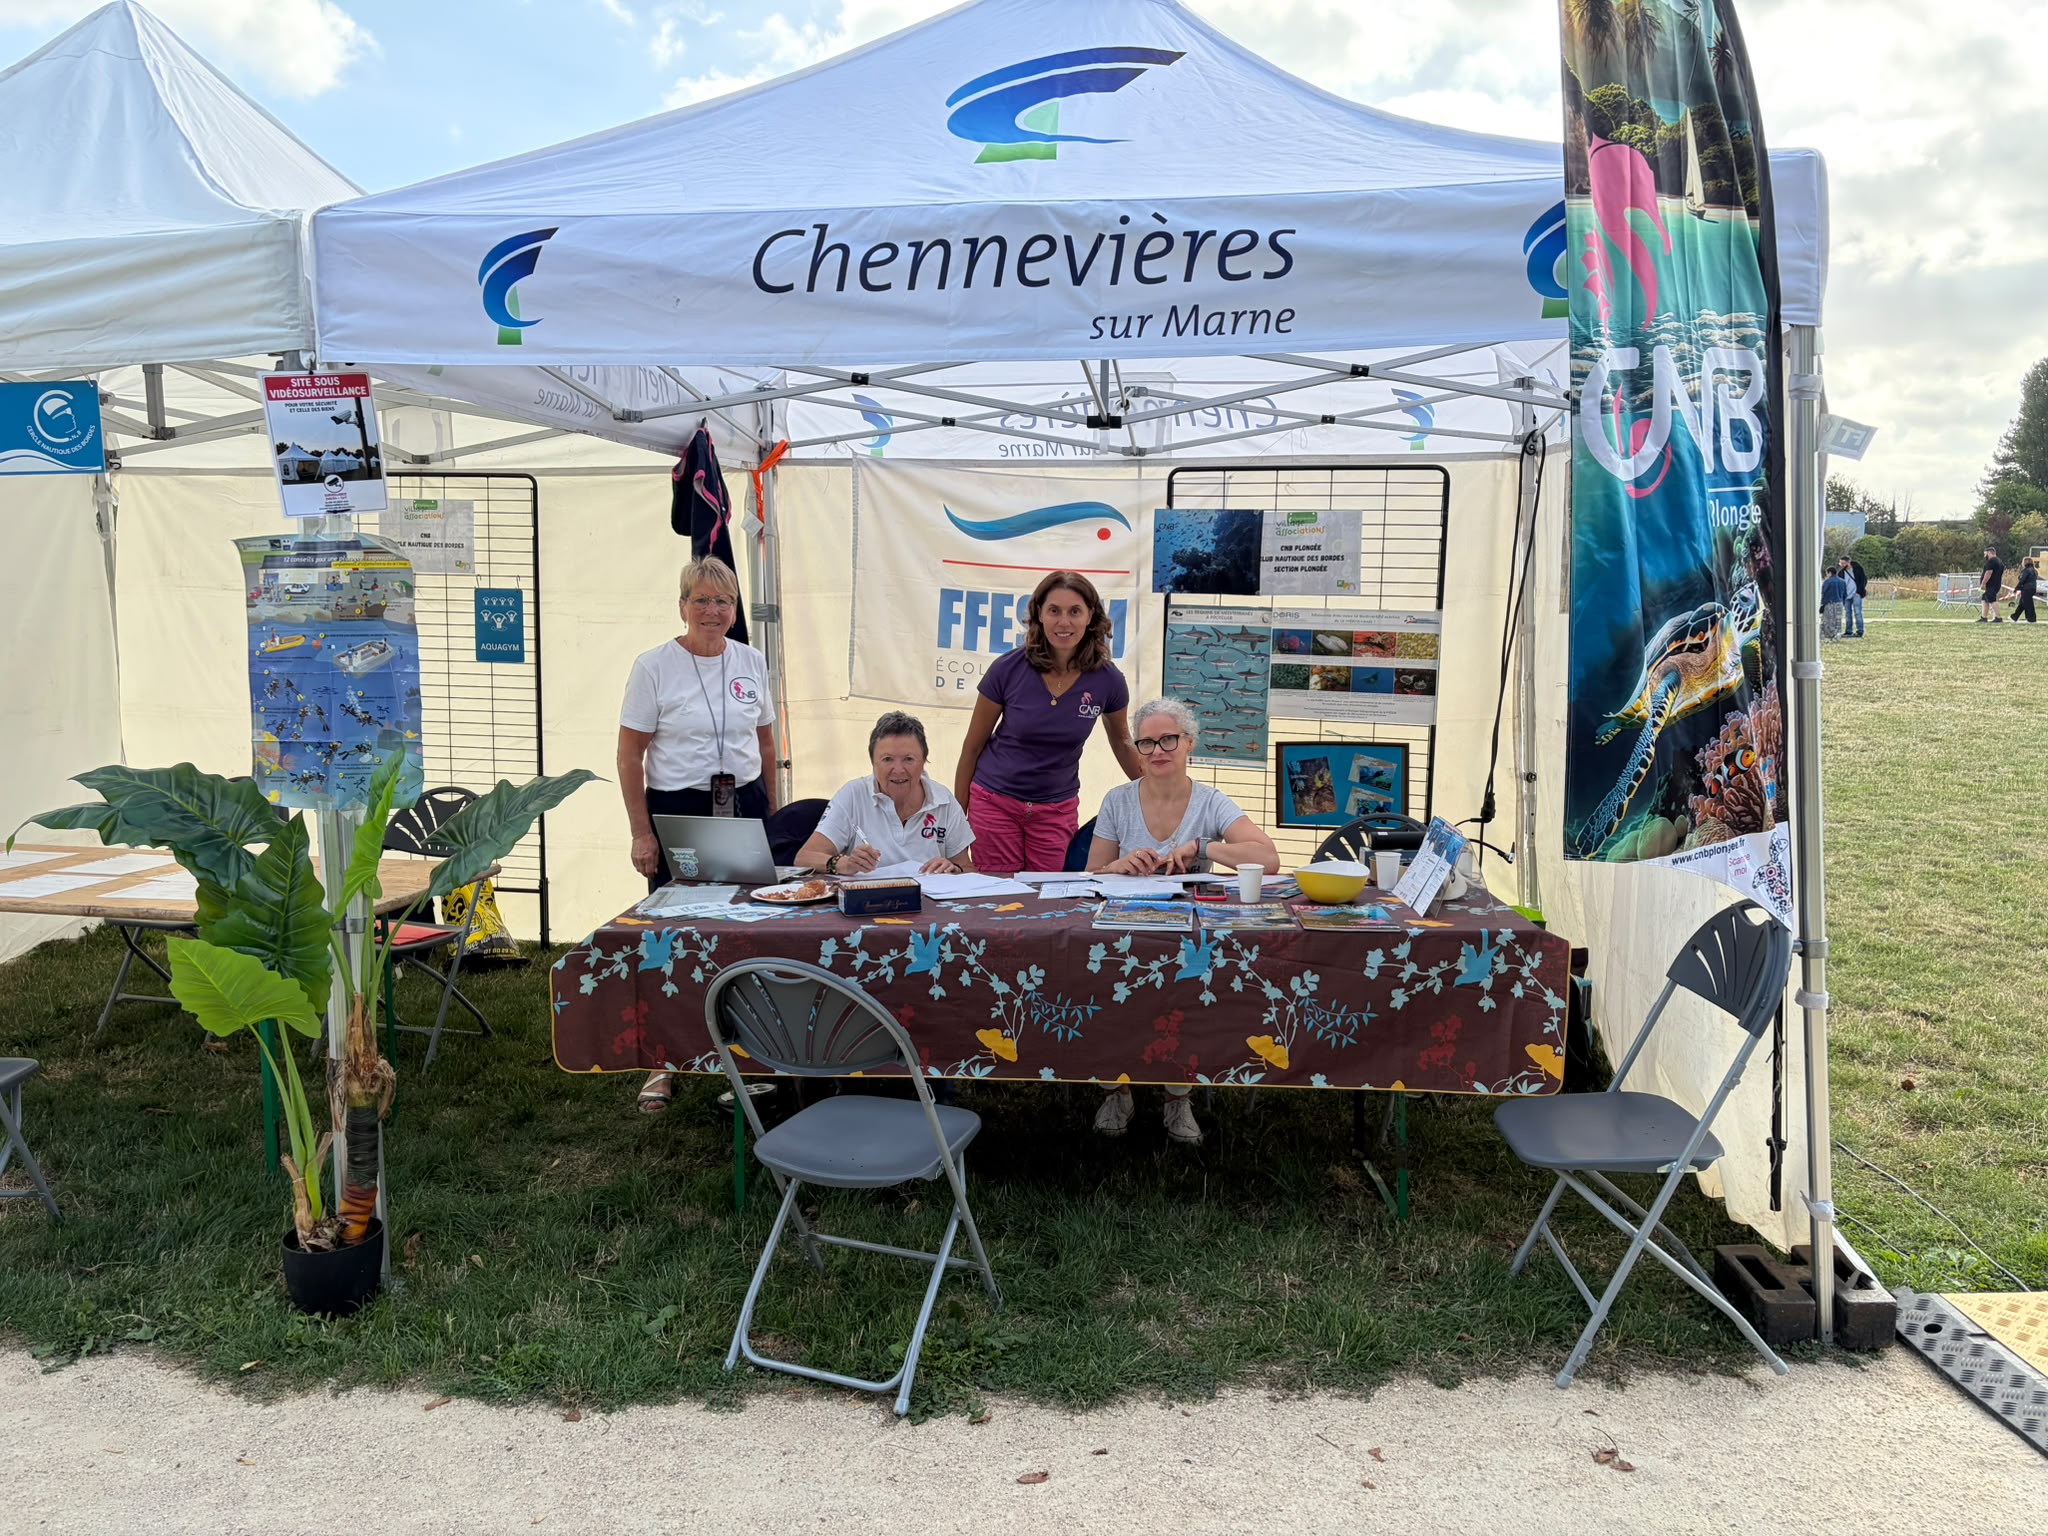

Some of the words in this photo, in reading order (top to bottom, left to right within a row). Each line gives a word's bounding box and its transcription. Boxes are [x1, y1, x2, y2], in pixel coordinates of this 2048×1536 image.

[752, 212, 1297, 294] Chennevières
[1089, 313, 1153, 339] sur
[1162, 305, 1296, 338] Marne
[290, 377, 312, 387] SITE
[314, 376, 341, 386] SOUS
[269, 386, 367, 399] VIDÉOSURVEILLANCE
[1580, 345, 1764, 481] CNB
[26, 425, 42, 446] CERCLE
[40, 442, 71, 455] NAUTIQUE
[71, 444, 83, 453] DES
[80, 424, 96, 447] BORDES
[1294, 543, 1322, 551] PLONGÉE
[1300, 564, 1328, 572] PLONGÉE
[480, 642, 520, 651] AQUAGYM
[1079, 704, 1101, 716] CNB
[920, 826, 947, 840] CNB
